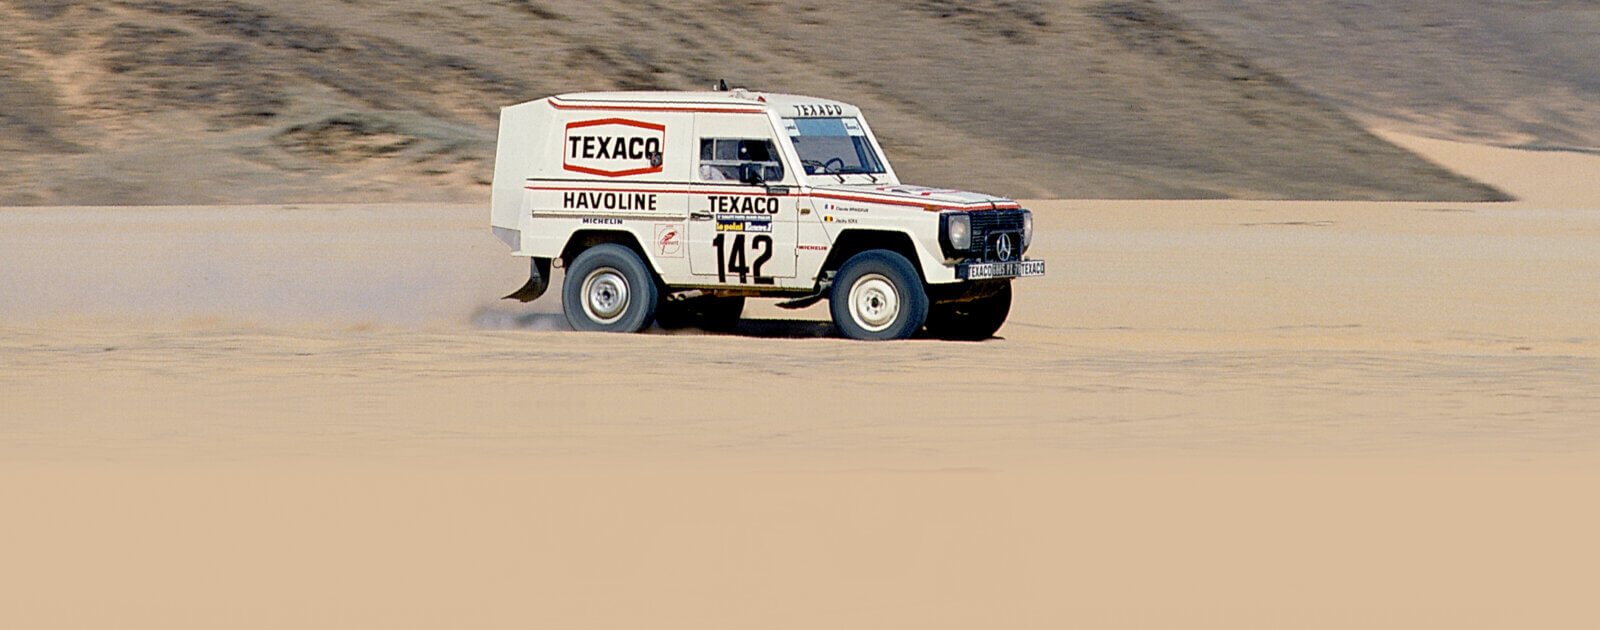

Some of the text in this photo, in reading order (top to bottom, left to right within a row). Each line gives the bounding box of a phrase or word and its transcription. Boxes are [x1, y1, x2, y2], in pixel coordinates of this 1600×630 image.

[793, 104, 842, 116] TEXACO
[568, 136, 660, 160] TEXACO
[563, 191, 657, 210] HAVOLINE
[708, 195, 779, 214] TEXACO
[582, 217, 623, 225] MICHELIN
[724, 221, 743, 232] point
[712, 233, 775, 284] 142
[968, 264, 992, 278] TEXACO
[1021, 262, 1045, 275] TEXACO
